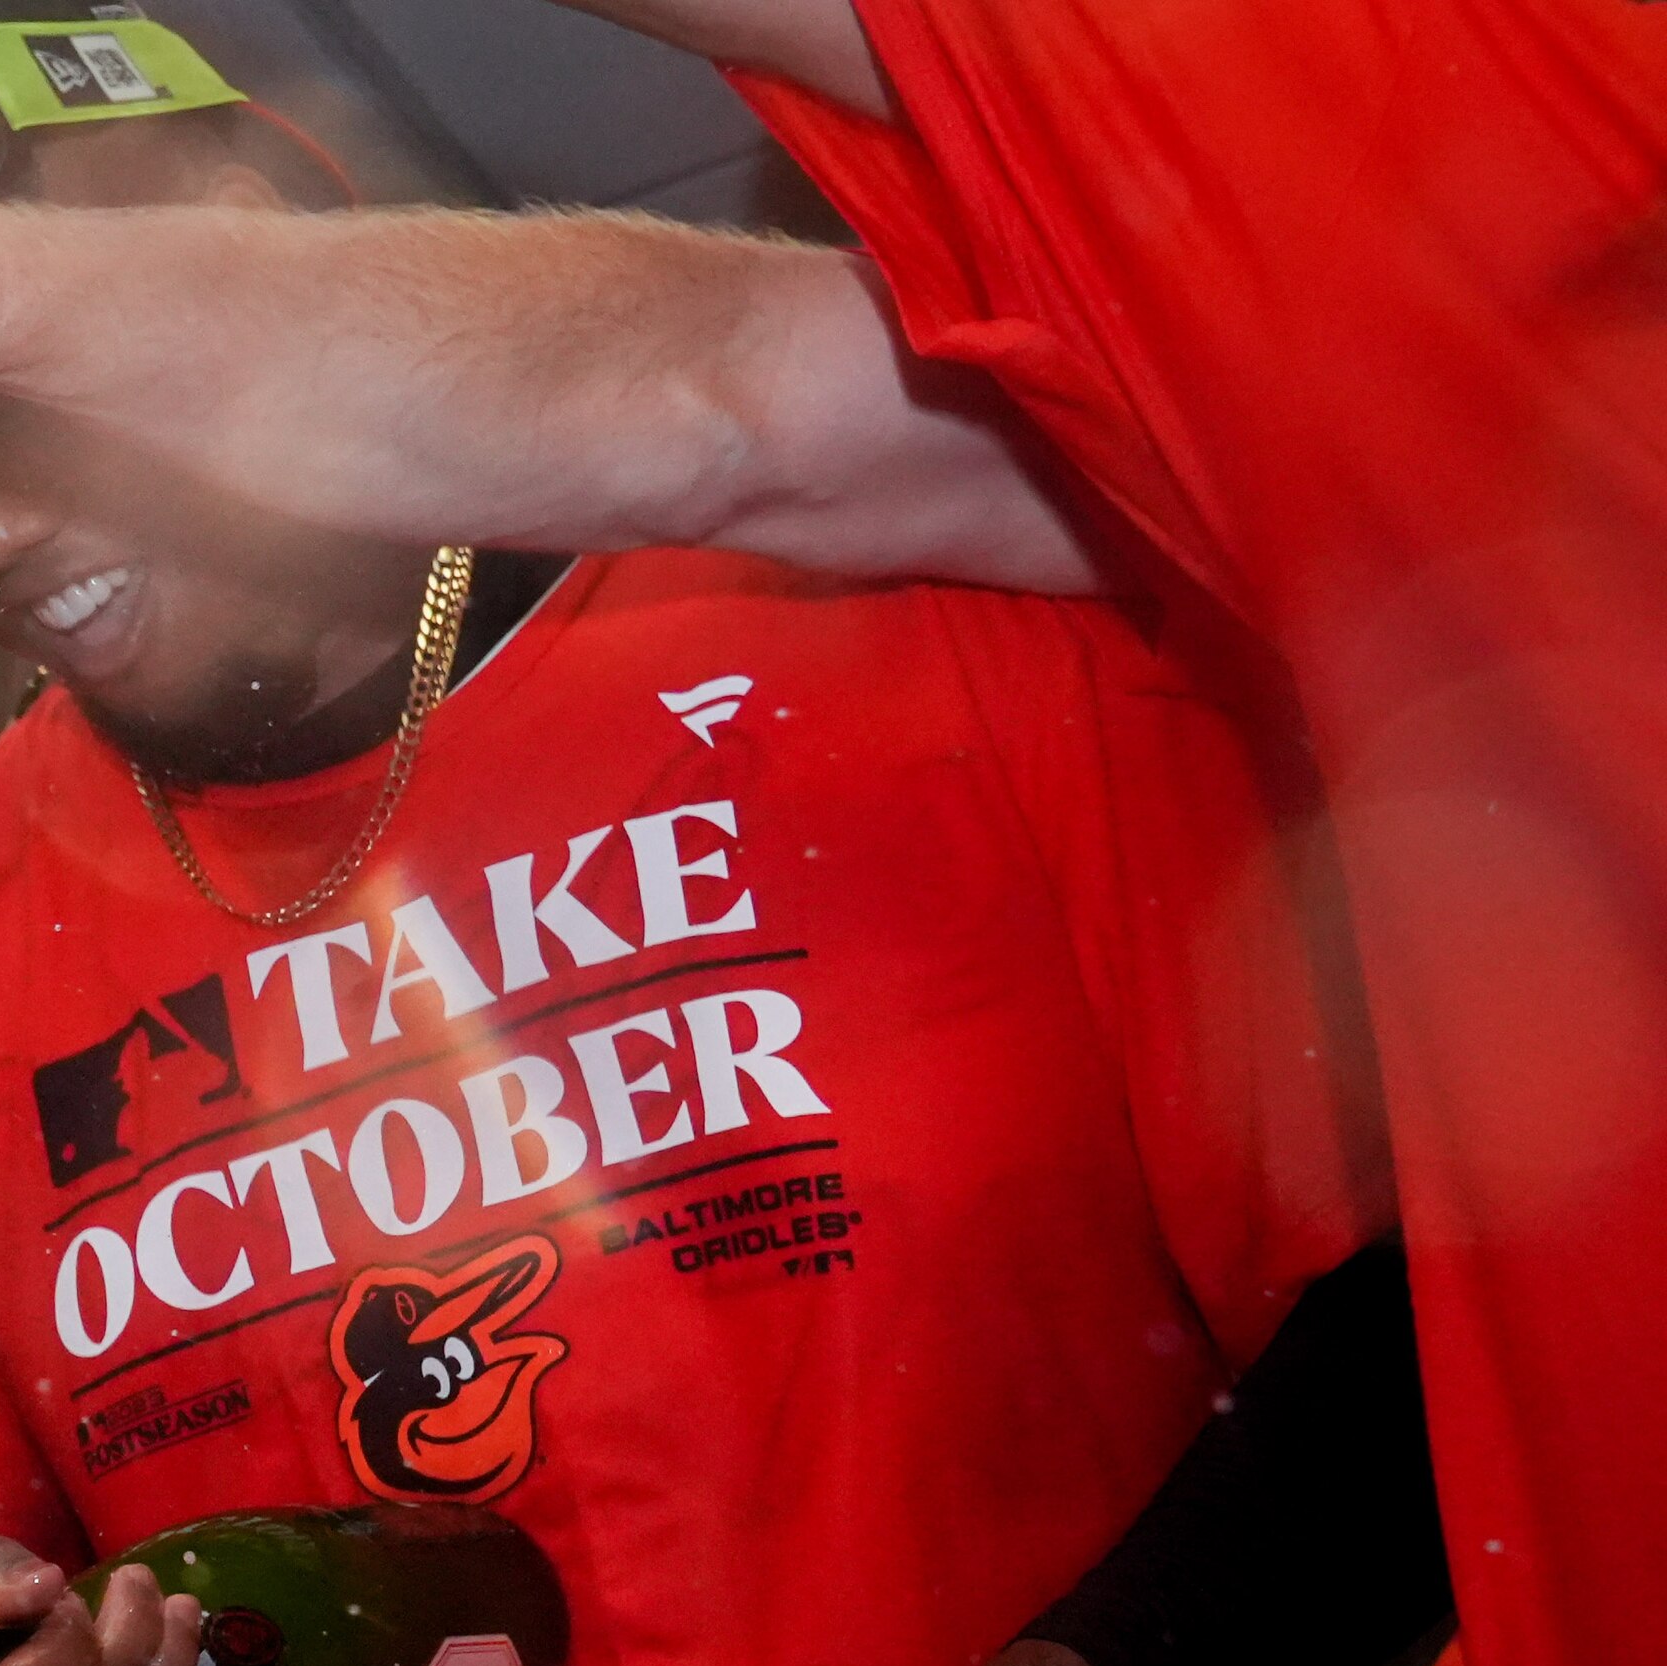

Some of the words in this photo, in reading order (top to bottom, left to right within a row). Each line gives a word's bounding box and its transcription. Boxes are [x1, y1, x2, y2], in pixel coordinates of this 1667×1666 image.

[246, 800, 757, 1072] TAKE
[54, 988, 832, 1358] OCTOBER
[598, 1172, 845, 1256] BALTIMORE
[83, 1385, 252, 1476] POSTSEASON
